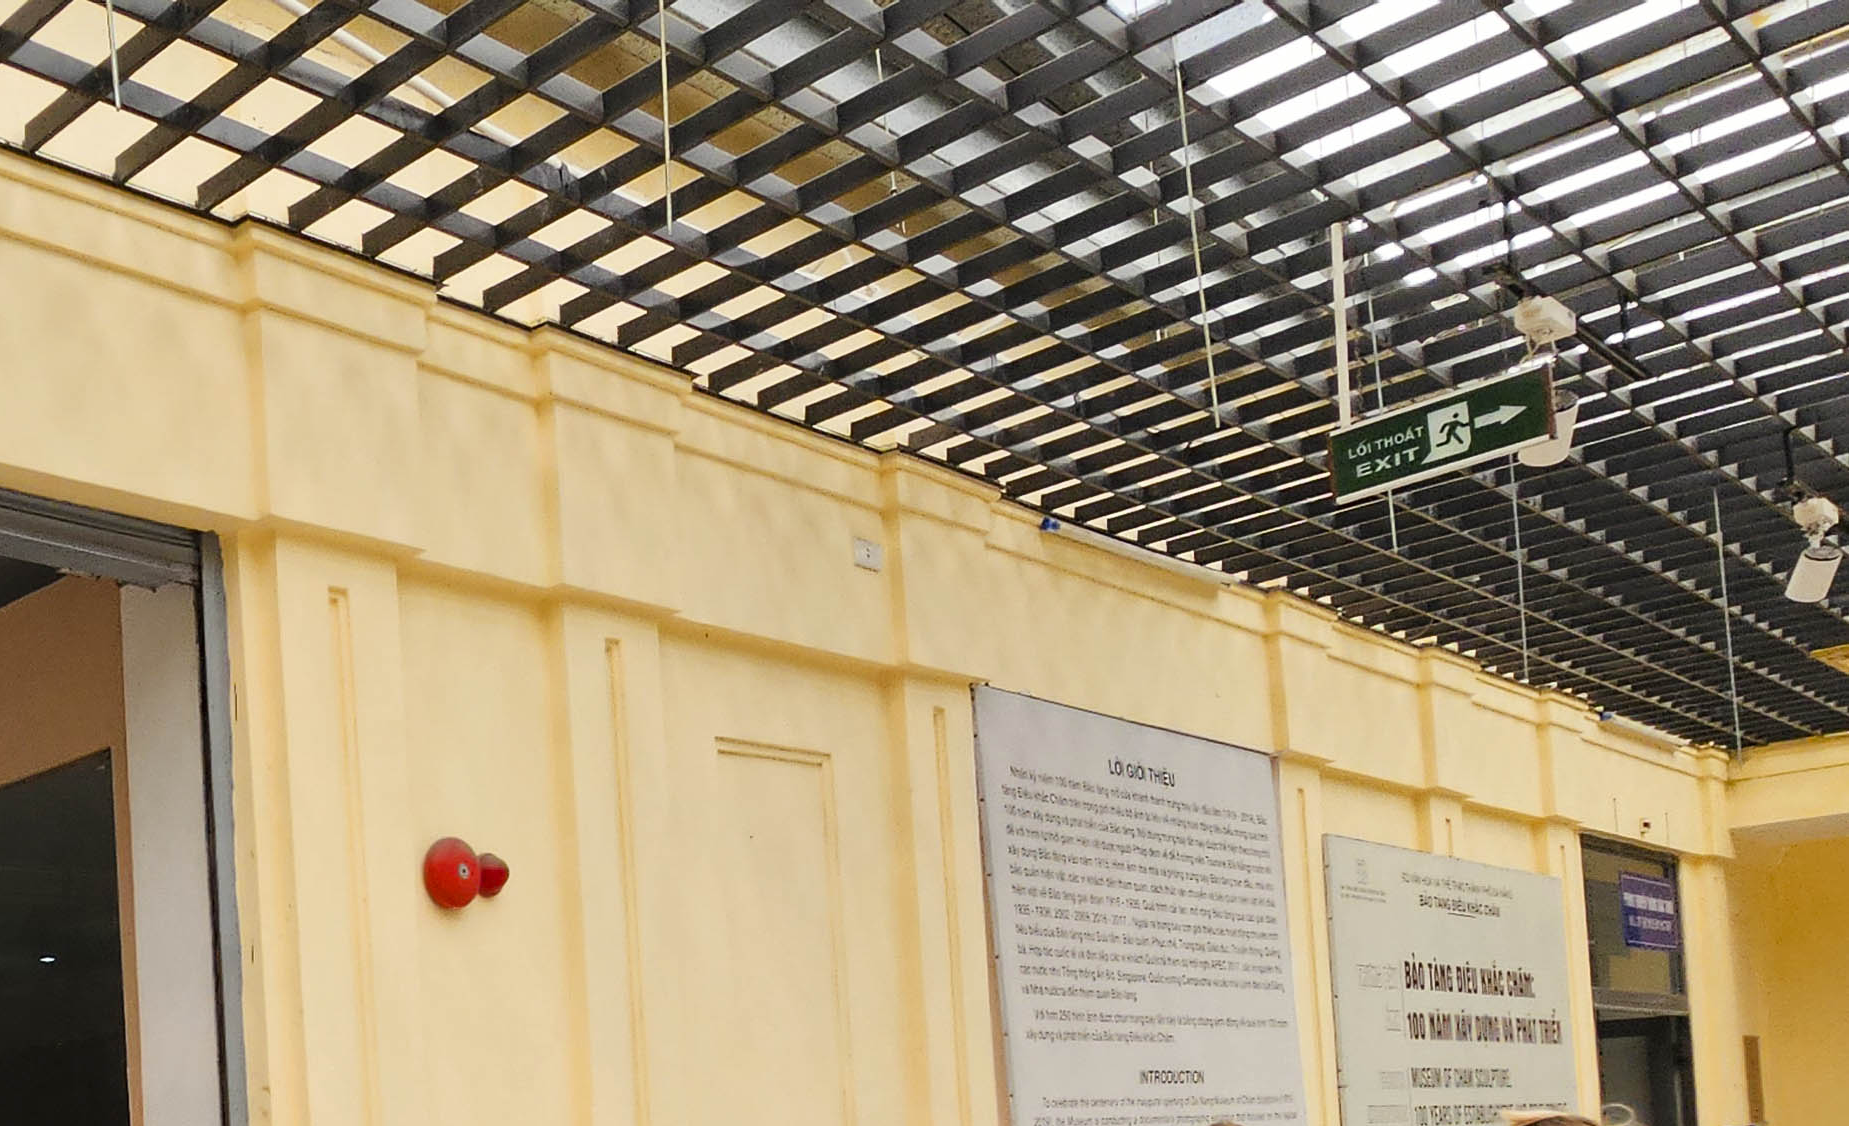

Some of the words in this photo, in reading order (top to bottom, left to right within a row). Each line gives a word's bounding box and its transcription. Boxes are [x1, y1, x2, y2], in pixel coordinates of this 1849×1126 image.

[1374, 426, 1424, 450] THOÁT
[1356, 446, 1420, 478] EXIT
[1404, 952, 1425, 990] BẢO
[1428, 957, 1454, 992] TÀNG
[1407, 1012, 1426, 1040] 100
[1139, 1069, 1205, 1085] INTRODUCTION
